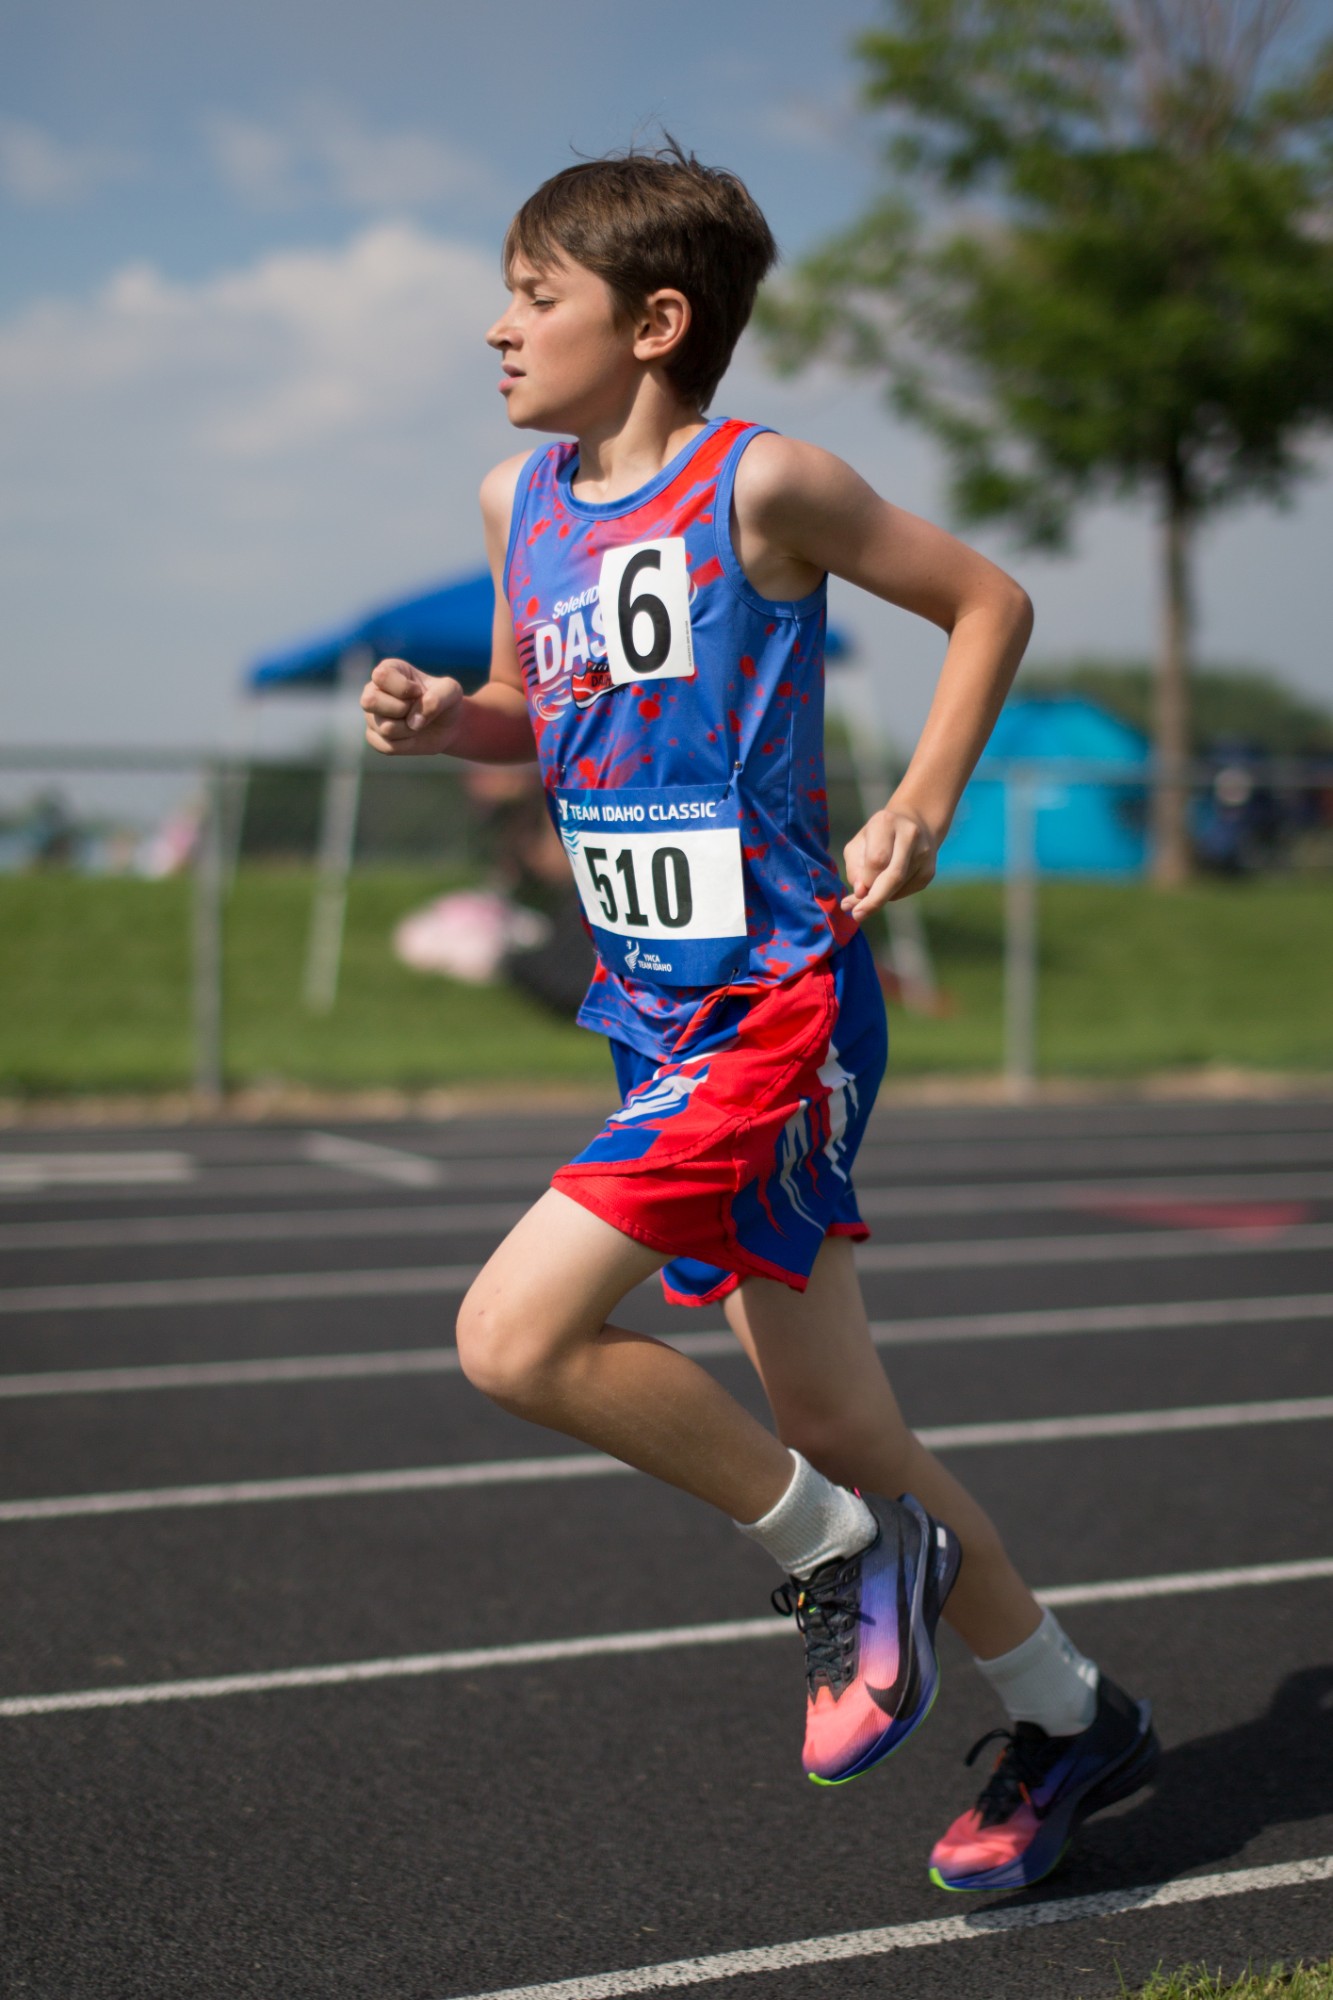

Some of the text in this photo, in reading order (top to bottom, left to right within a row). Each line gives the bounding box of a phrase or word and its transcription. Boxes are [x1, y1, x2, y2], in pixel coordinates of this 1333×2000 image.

[535, 602, 608, 684] DAS
[552, 585, 600, 619] SoleKID
[618, 548, 671, 674] 6
[569, 805, 600, 821] TEAM
[602, 805, 645, 822] IDAHO
[649, 802, 717, 821] CLASSIC
[584, 846, 693, 929] 510
